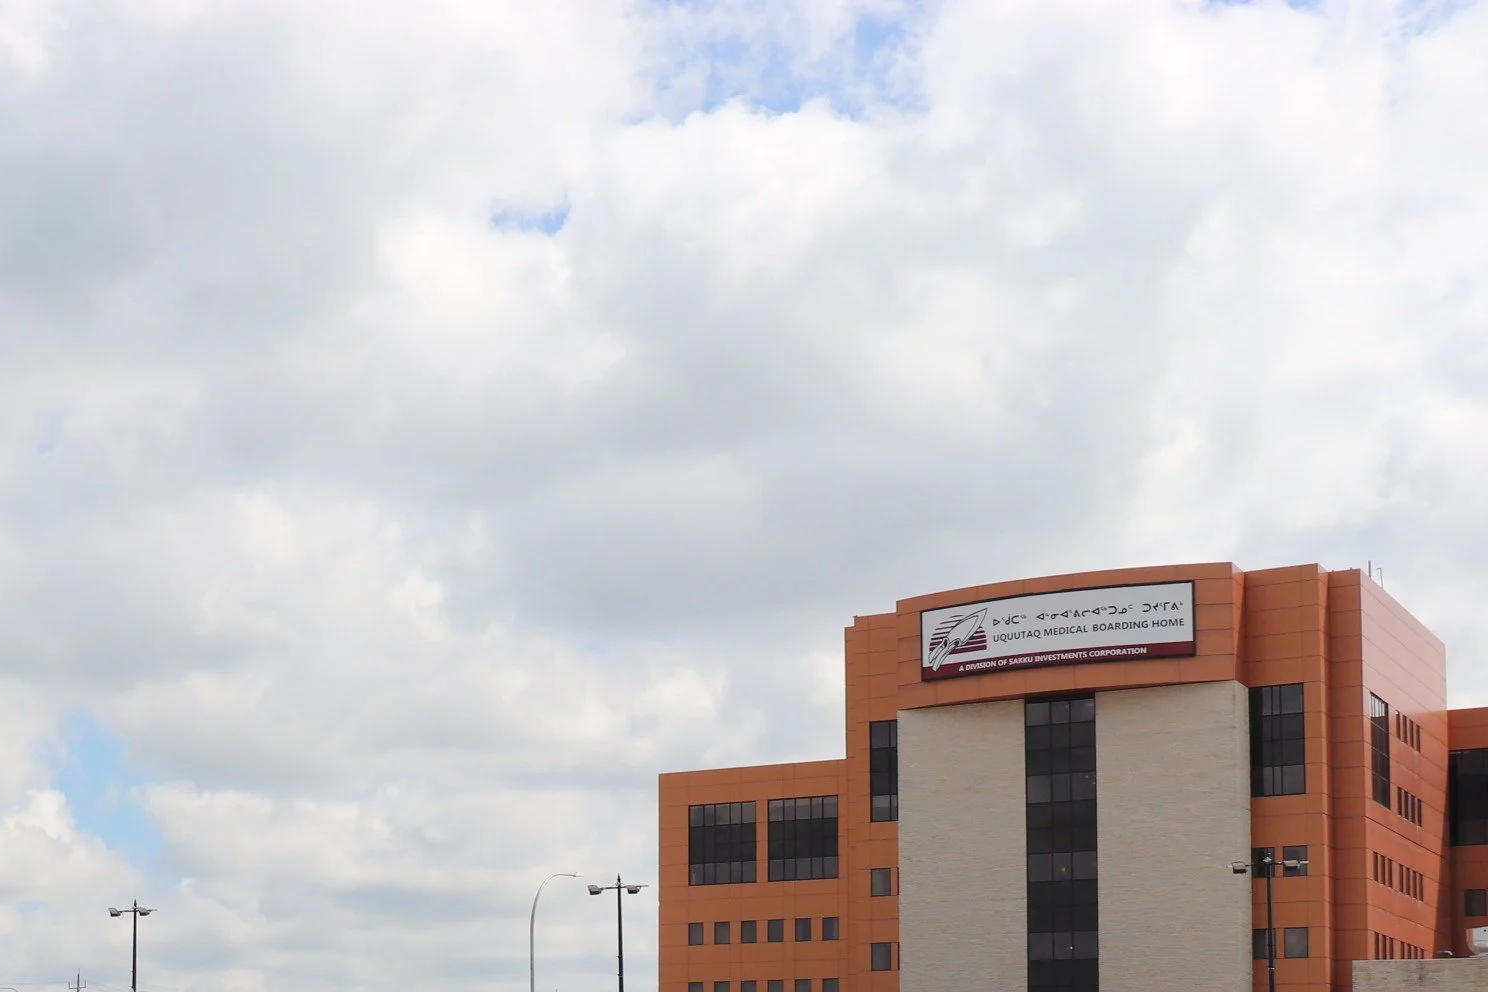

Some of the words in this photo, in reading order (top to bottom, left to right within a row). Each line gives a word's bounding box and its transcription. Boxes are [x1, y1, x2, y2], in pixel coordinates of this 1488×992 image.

[993, 629, 1041, 643] UQUUTAQ
[1043, 625, 1089, 637] MEDICAL
[1092, 619, 1149, 632] BOARDING
[1152, 618, 1185, 628] HOME
[965, 661, 997, 671] DIVISION
[998, 659, 1008, 667] OF
[1008, 656, 1033, 665] SAKKU
[1034, 651, 1088, 662] INVESTMENTS
[1089, 647, 1147, 658] CORPORATION
